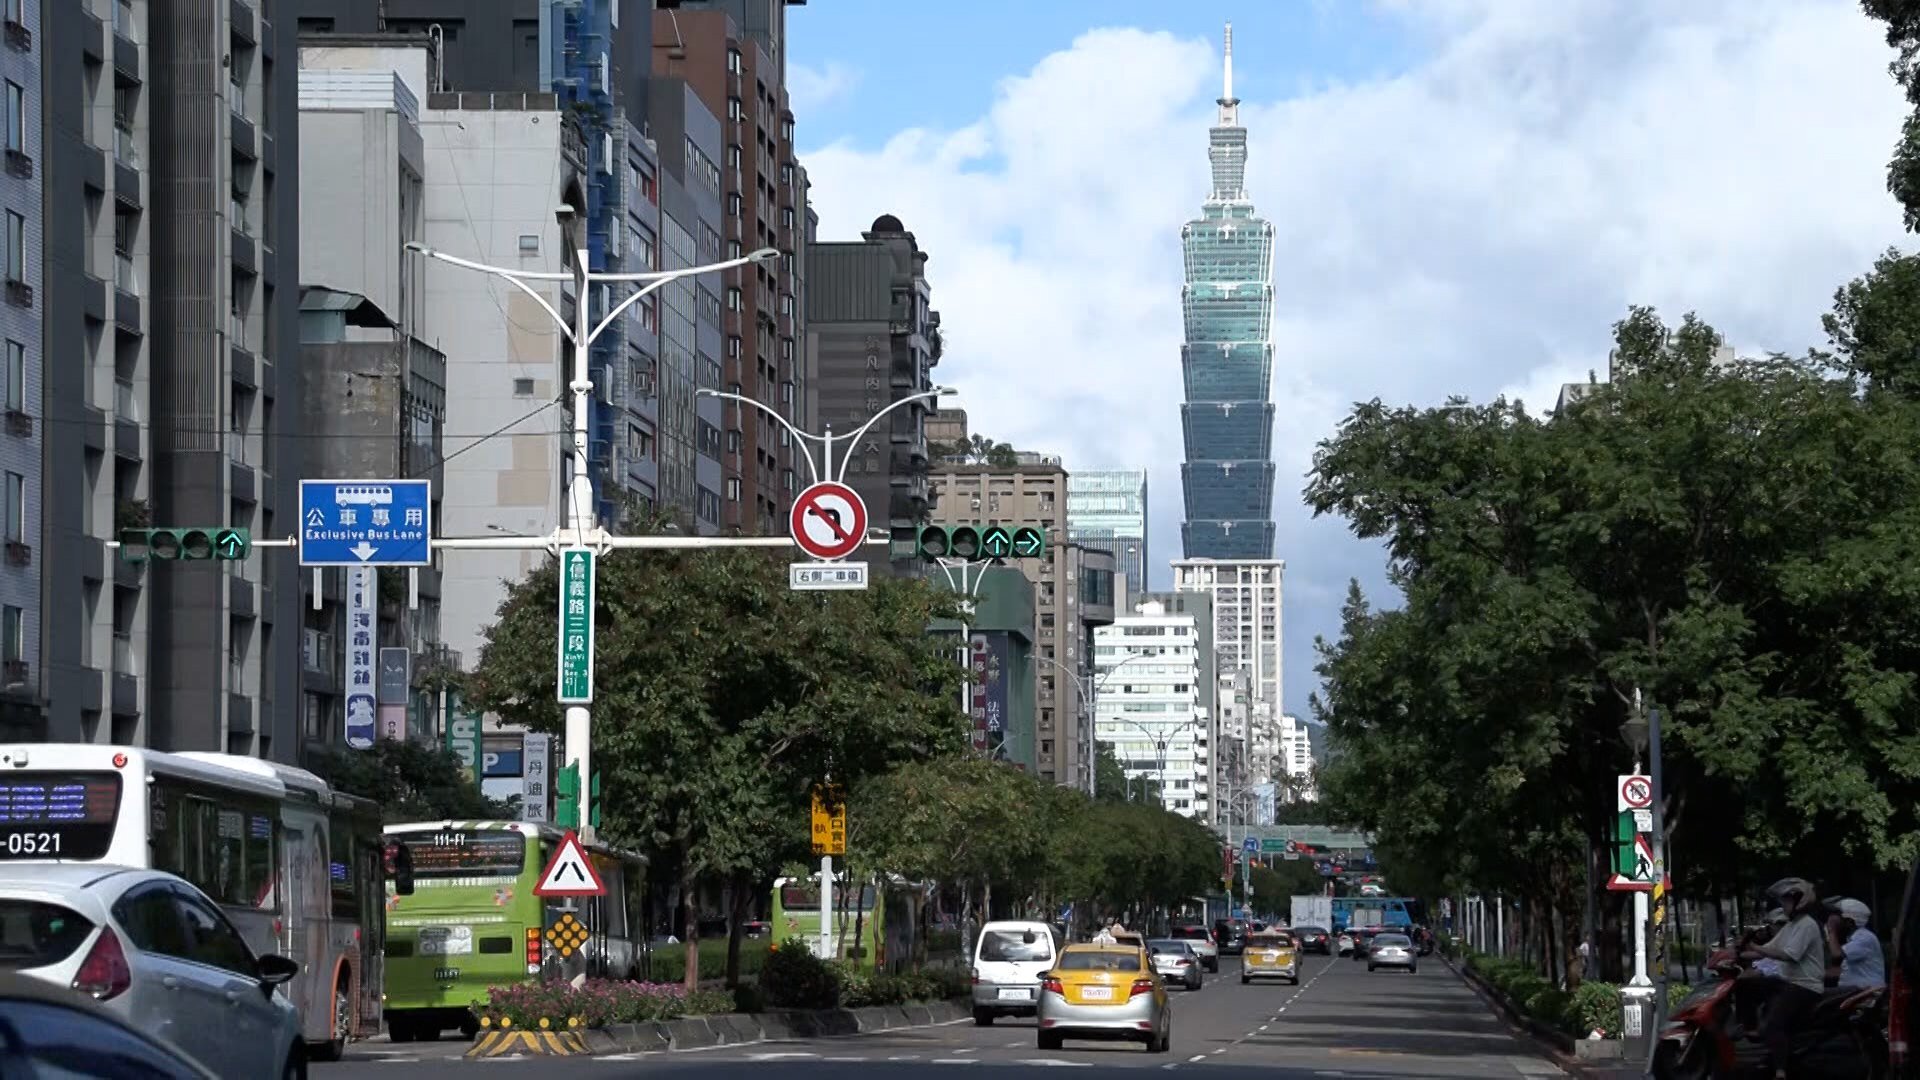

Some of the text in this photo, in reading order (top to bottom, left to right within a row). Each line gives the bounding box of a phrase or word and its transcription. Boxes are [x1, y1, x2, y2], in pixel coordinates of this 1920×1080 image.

[306, 507, 423, 526] 公車專用
[305, 529, 423, 540] Exclusive Bus Lane
[568, 563, 585, 652] 信義路三段
[434, 833, 466, 846] 111-FY
